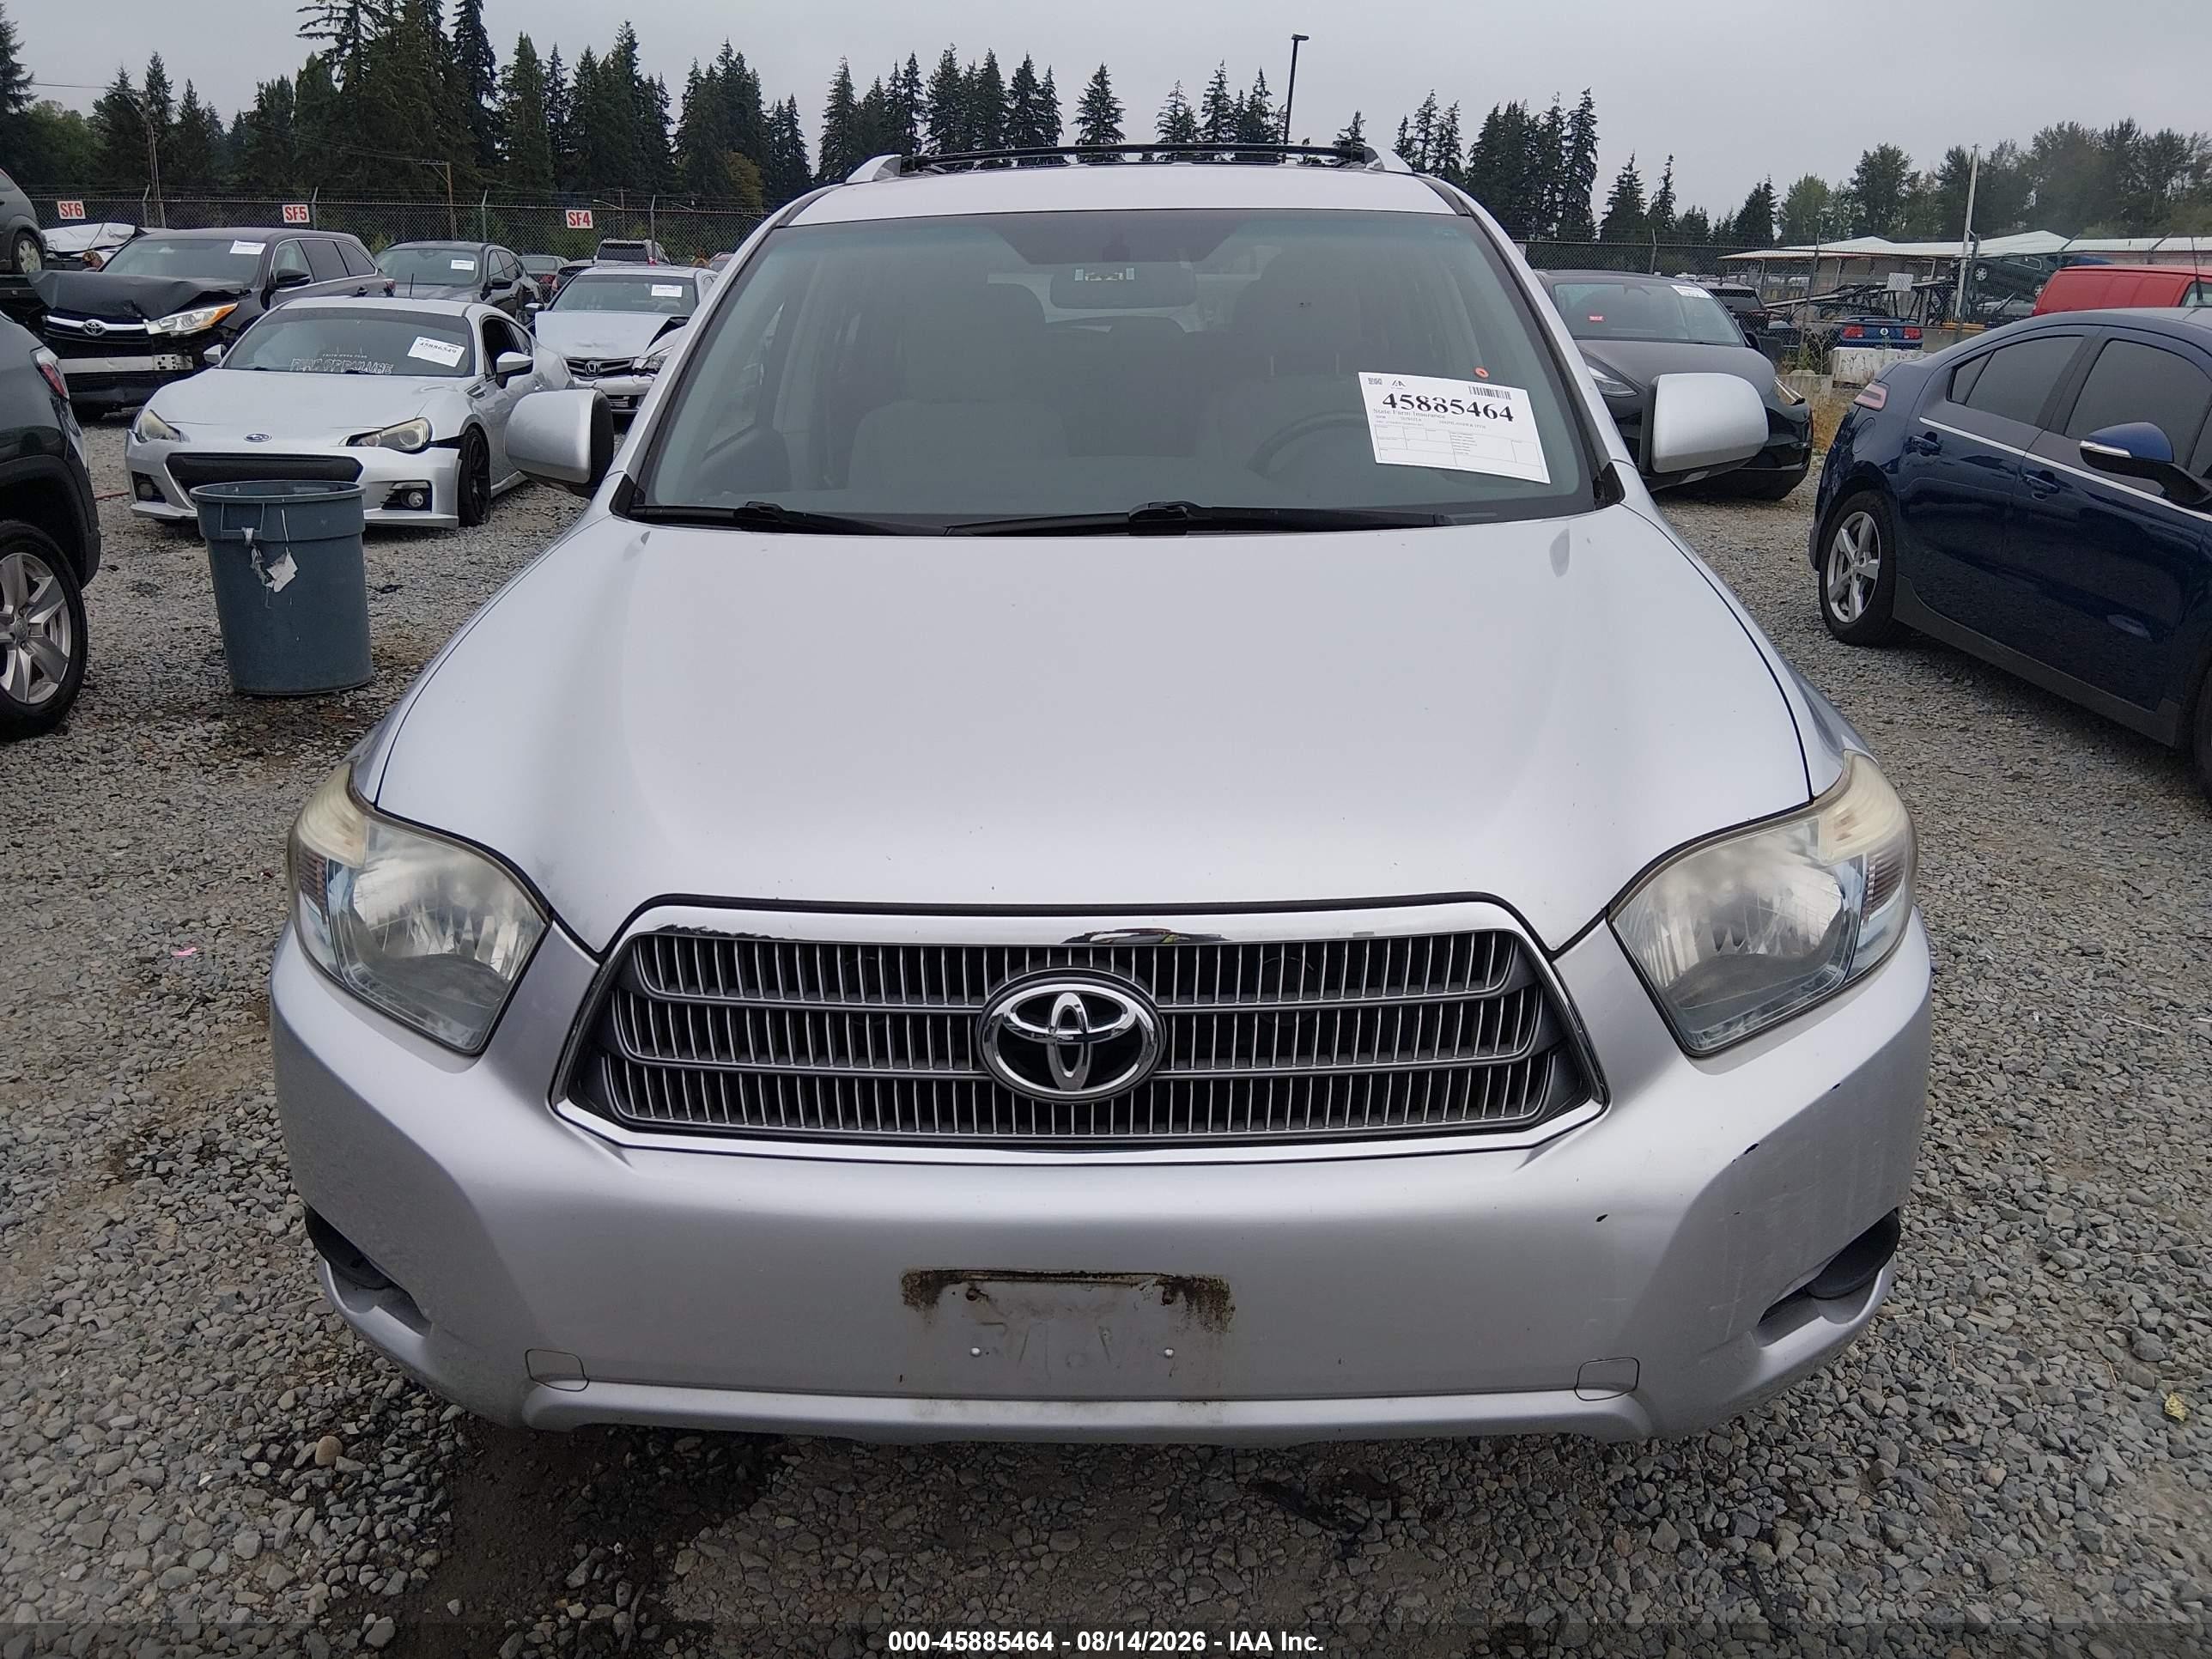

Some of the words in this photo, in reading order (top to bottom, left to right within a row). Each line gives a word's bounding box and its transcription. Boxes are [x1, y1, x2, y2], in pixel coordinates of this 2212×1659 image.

[60, 203, 83, 217] SF6
[284, 206, 307, 221] SF5
[568, 211, 592, 227] SF4
[1382, 392, 1514, 422] 45885464
